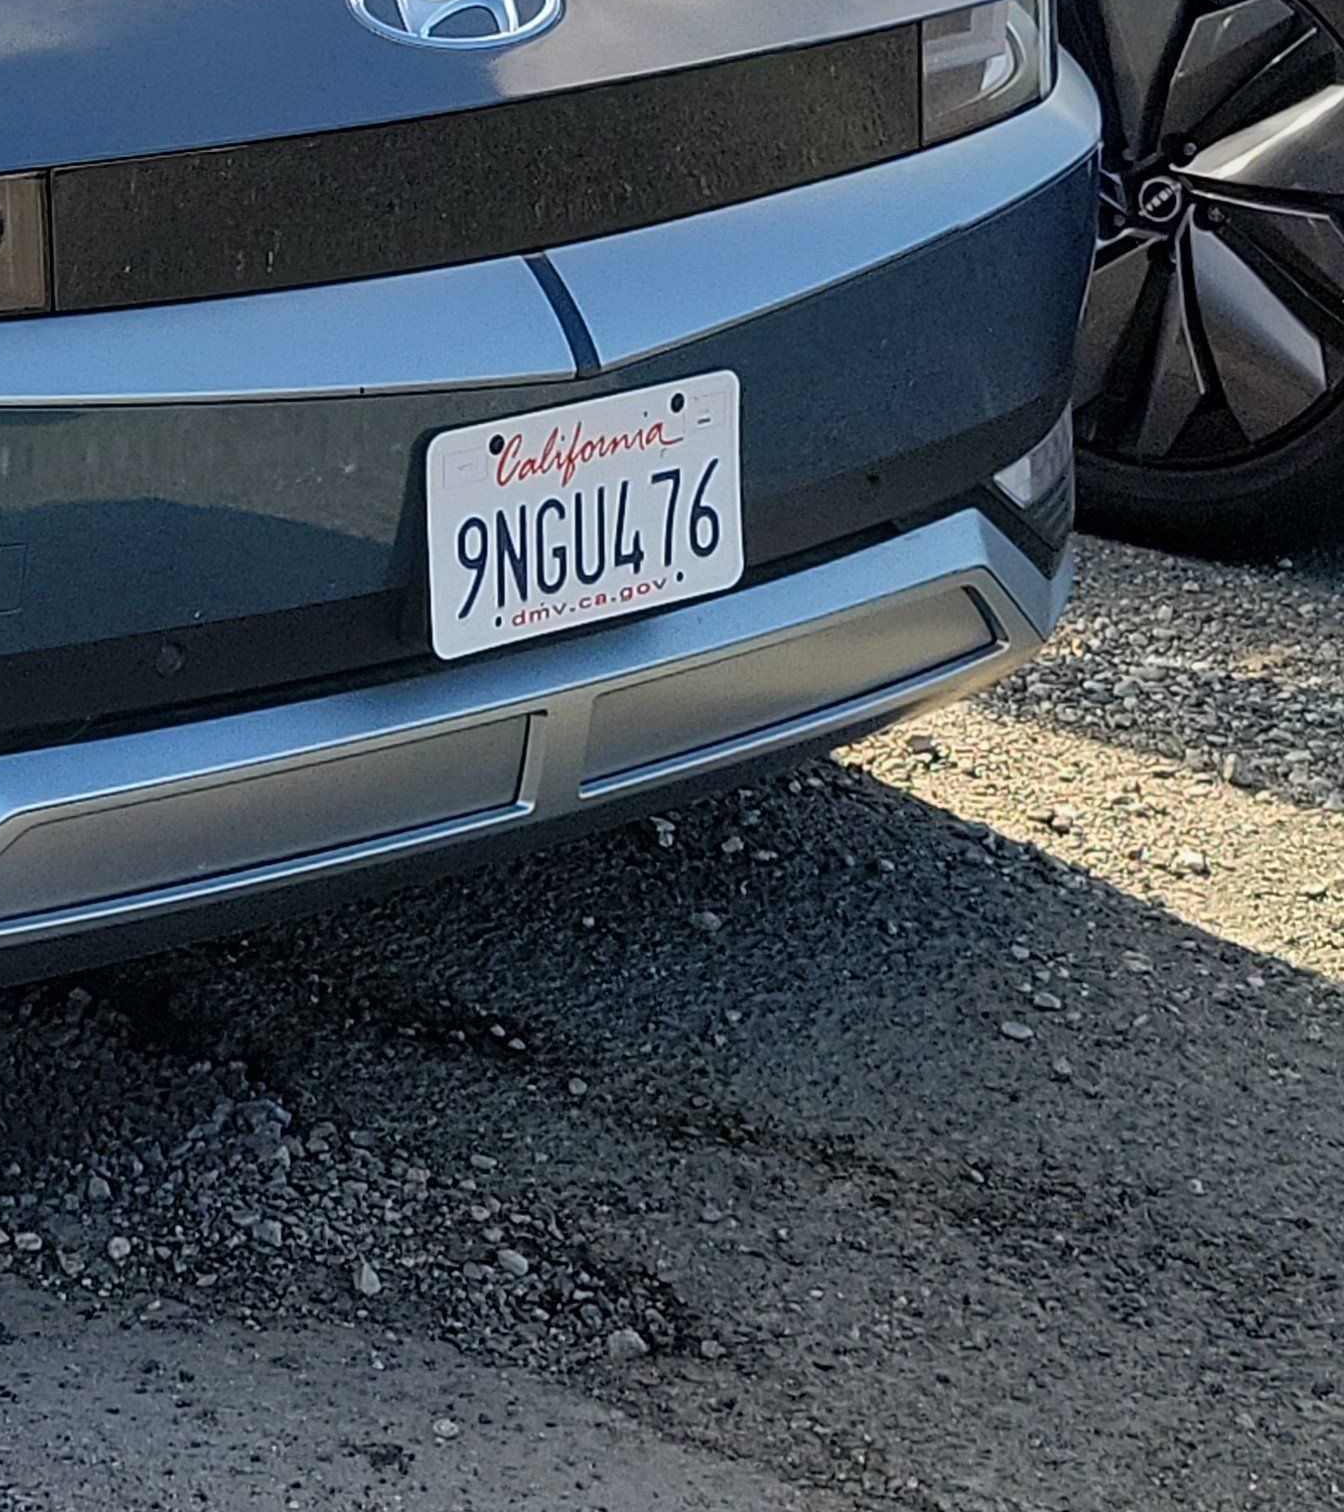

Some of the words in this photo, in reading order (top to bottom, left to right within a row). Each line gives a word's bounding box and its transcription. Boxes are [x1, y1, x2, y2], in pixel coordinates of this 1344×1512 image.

[495, 411, 684, 487] California
[457, 458, 720, 619] 9NGU476
[511, 576, 668, 627] dmv.ca.gov
